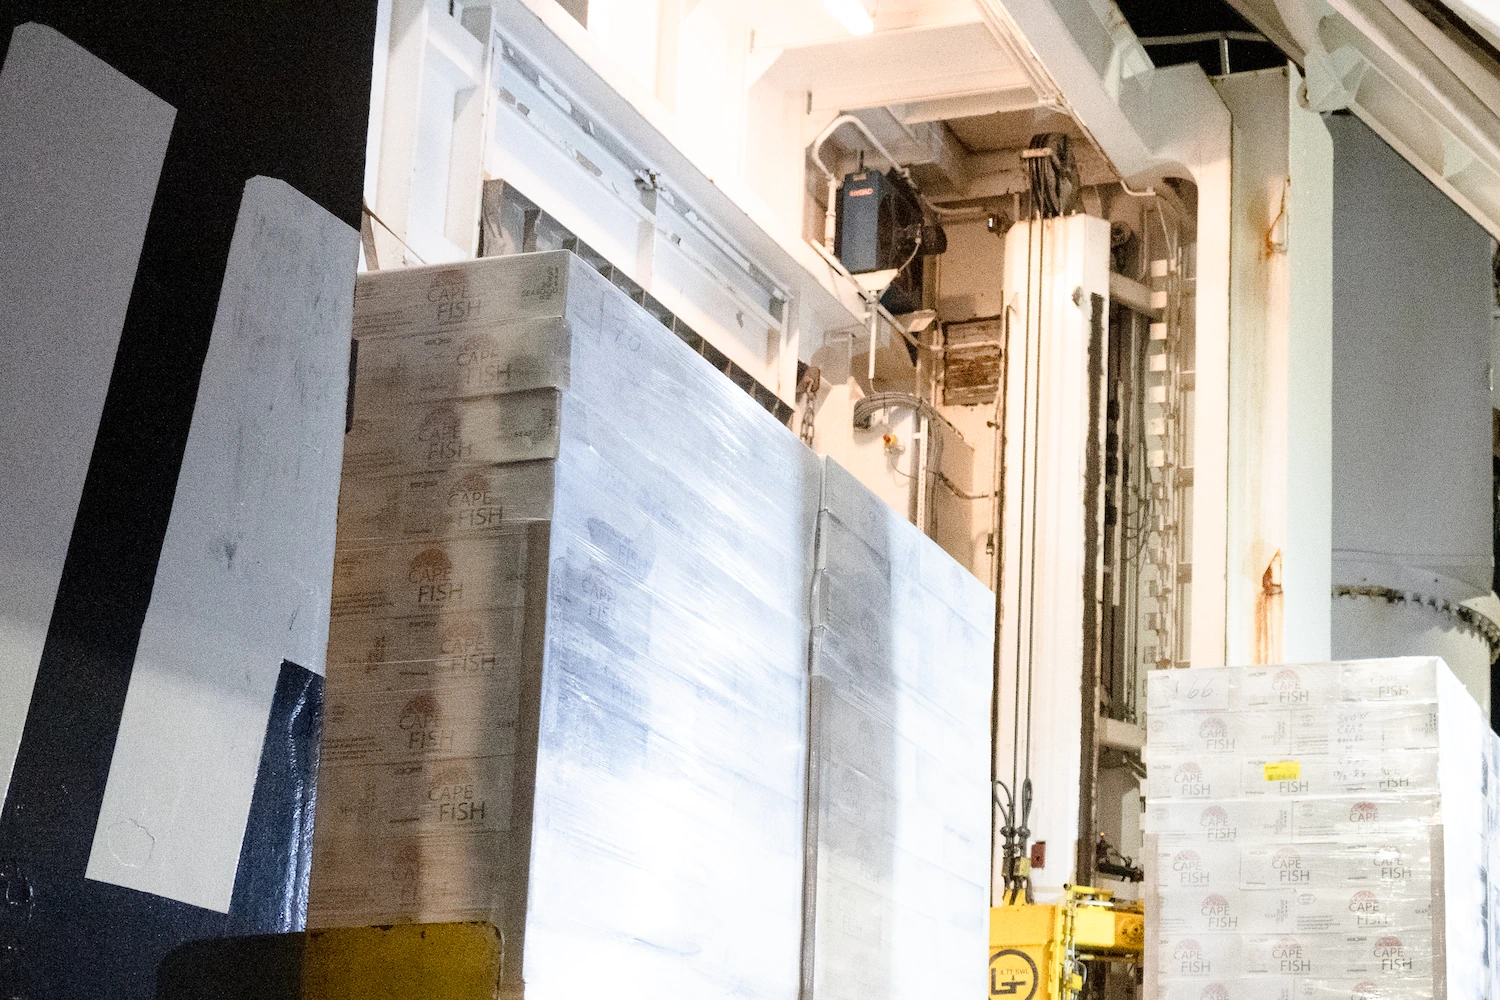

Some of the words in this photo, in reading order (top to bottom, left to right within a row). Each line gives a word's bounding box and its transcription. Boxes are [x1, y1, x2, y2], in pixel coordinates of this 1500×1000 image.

[427, 286, 468, 302] CAPE
[437, 300, 481, 320] FISH
[447, 491, 493, 508] CAPE
[418, 583, 463, 602] FISH
[1271, 680, 1301, 691] CAPE
[1279, 690, 1309, 703] FISH
[1199, 729, 1228, 739] CAPE
[1206, 739, 1236, 750] FISH
[1174, 773, 1203, 784] CAPE
[428, 784, 474, 801] CAPE
[1181, 784, 1211, 796] FISH
[1279, 780, 1309, 793] FISH
[440, 801, 486, 821] FISH
[1200, 817, 1229, 827] CAPE
[1349, 812, 1380, 823] CAPE
[1207, 828, 1237, 840] FISH
[1172, 860, 1202, 872] CAPE
[1271, 859, 1302, 870] CAPE
[1180, 871, 1210, 884] FISH
[1279, 869, 1310, 882] FISH
[1381, 867, 1412, 880] FISH
[1200, 906, 1230, 917] CAPE
[1348, 902, 1380, 912] CAPE
[1208, 916, 1238, 928] FISH
[1173, 949, 1203, 960] CAPE
[1271, 948, 1303, 960] CAPE
[1373, 947, 1404, 958] CAPE
[1181, 960, 1211, 973] FISH
[1280, 959, 1311, 972] FISH
[1381, 958, 1413, 971] FISH
